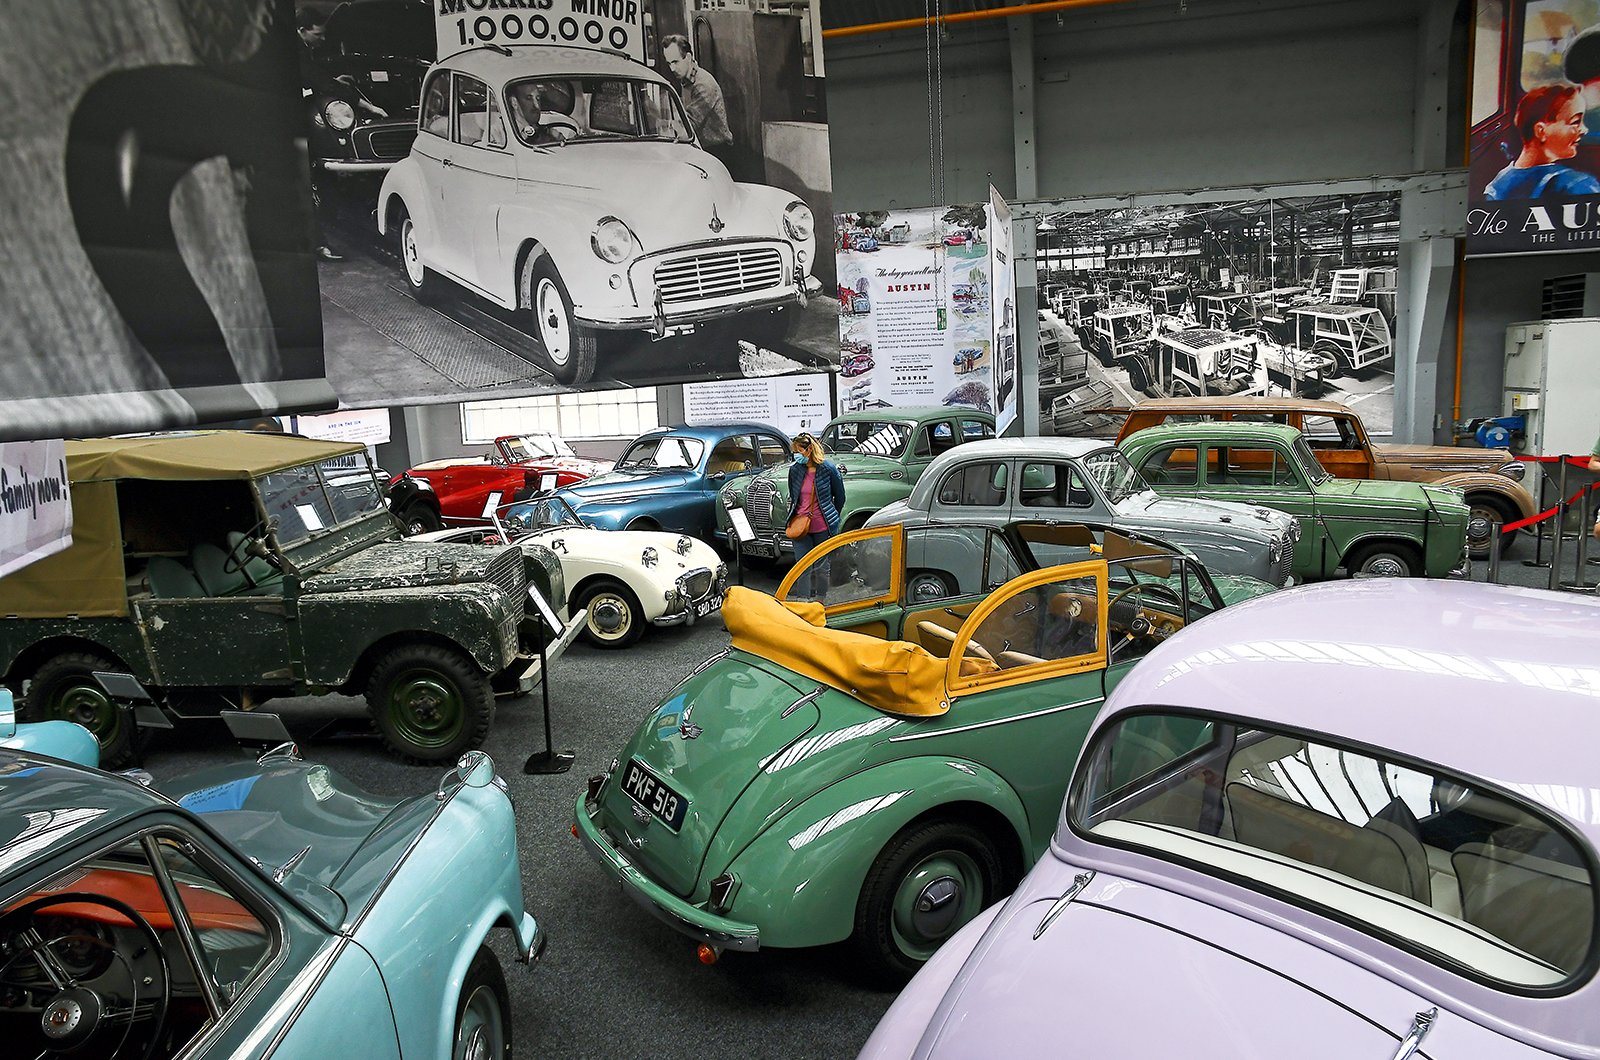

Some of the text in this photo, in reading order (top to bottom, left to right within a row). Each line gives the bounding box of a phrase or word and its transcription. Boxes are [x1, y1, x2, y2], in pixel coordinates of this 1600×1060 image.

[457, 14, 628, 49] 1,000,000
[1466, 208, 1508, 236] The
[1531, 233, 1556, 243] THE
[875, 265, 943, 279] The day goes well with
[887, 283, 930, 292] AUSTIN
[1, 459, 67, 520] family now!
[626, 766, 656, 801] PKF
[652, 786, 679, 822] 513
